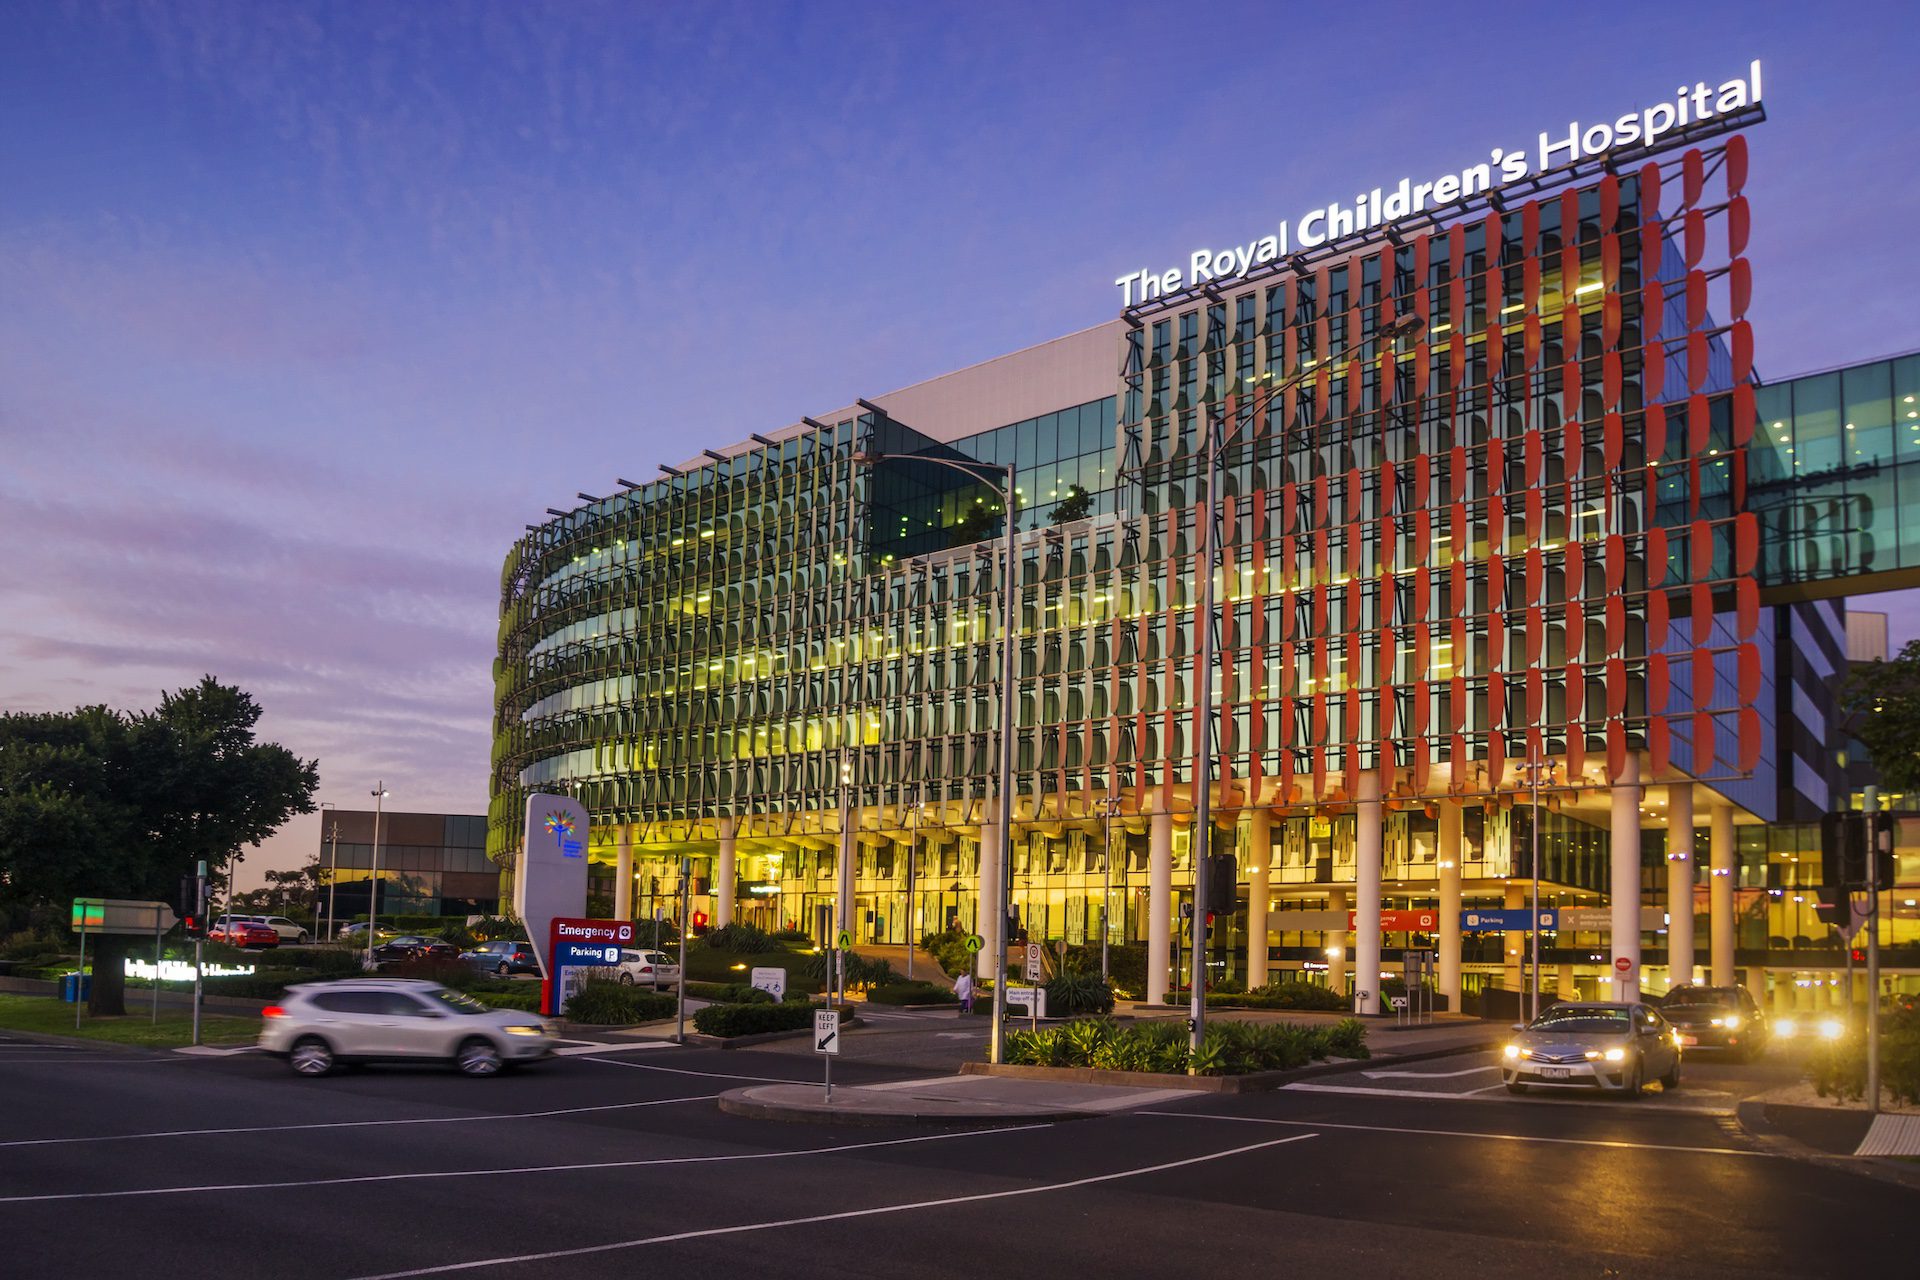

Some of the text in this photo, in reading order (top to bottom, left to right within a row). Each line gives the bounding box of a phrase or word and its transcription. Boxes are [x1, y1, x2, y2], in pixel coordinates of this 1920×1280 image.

[1114, 60, 1762, 308] The Royal Children's Hospital
[1480, 917, 1504, 925] Parking
[558, 923, 616, 939] Emergency
[570, 946, 603, 959] Parking
